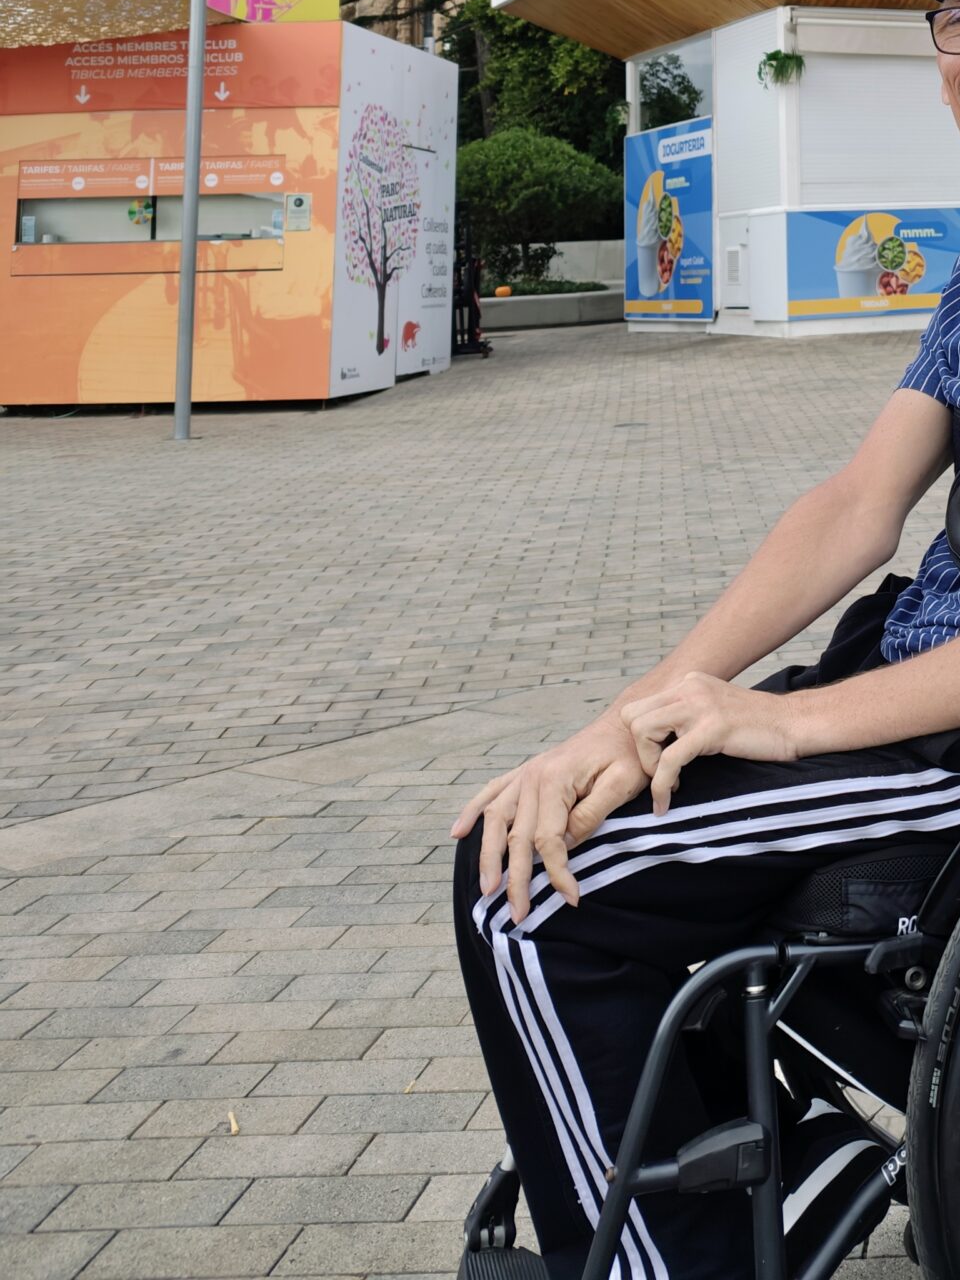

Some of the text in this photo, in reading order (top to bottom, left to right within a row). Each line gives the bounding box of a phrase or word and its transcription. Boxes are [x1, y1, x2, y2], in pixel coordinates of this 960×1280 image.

[116, 41, 176, 51] MEMBRES
[180, 39, 237, 49] TCLUB
[65, 56, 114, 66] ACCESO
[118, 54, 184, 65] MIEMBROS
[71, 69, 124, 80] TIBICLUB
[22, 165, 60, 174] TARIFES
[68, 164, 105, 173] TARIFAS
[205, 161, 243, 170] TARIFAS
[381, 182, 401, 198] PARC
[383, 201, 417, 222] NATURAL
